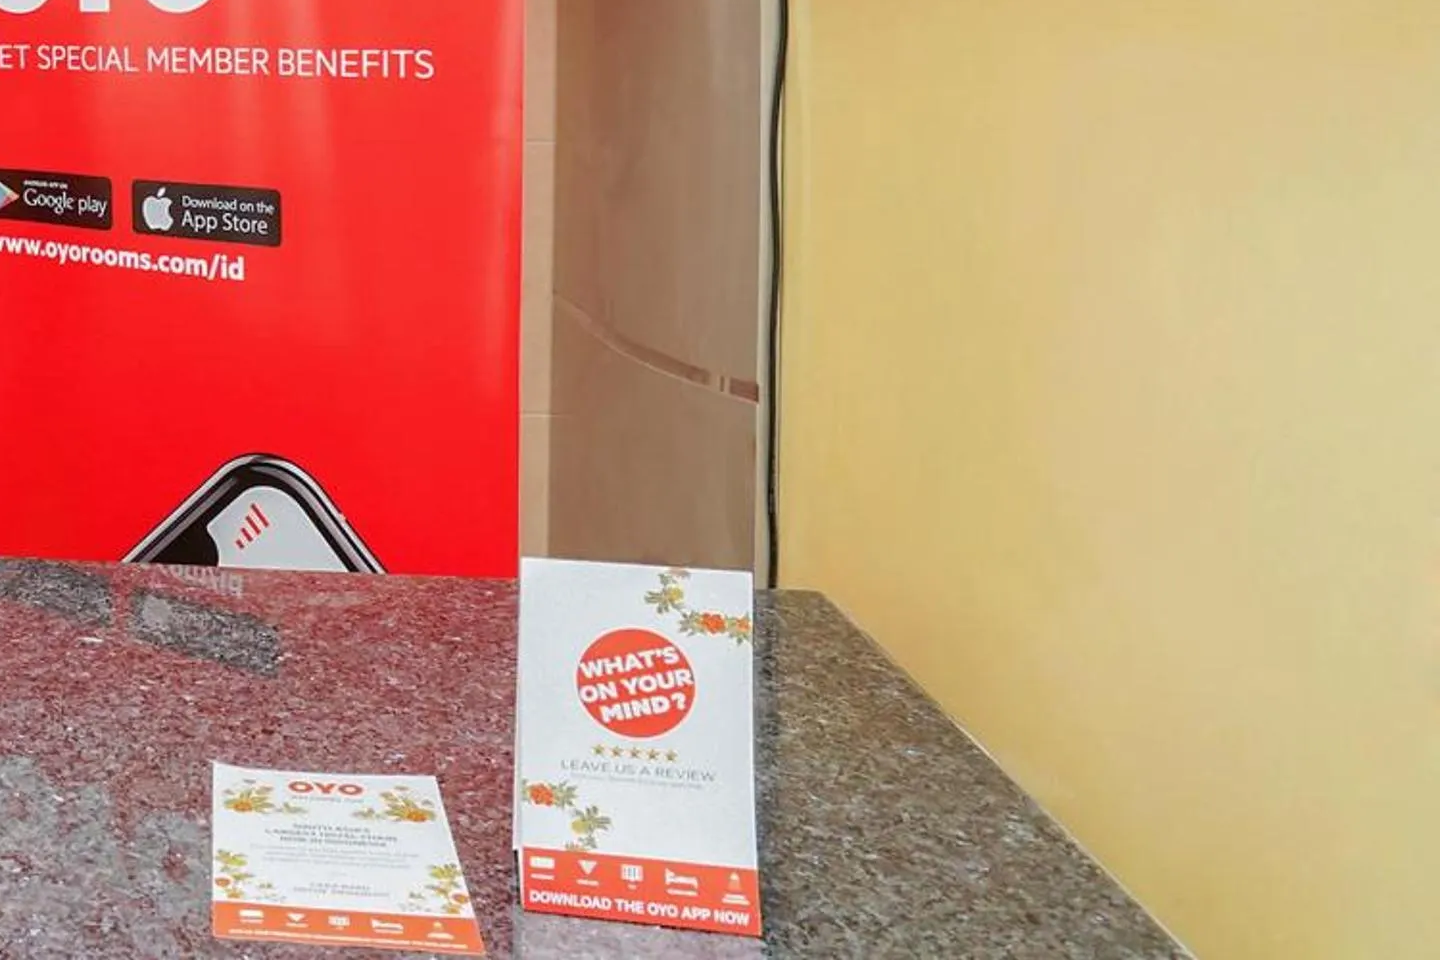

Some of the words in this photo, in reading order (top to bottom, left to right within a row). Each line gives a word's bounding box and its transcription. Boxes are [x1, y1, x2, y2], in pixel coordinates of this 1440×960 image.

[37, 45, 139, 73] SPECIAL
[147, 47, 269, 75] MEMBER
[278, 49, 435, 79] BENEFITS
[23, 188, 74, 215] Google
[78, 194, 108, 218] play
[181, 195, 237, 211] Download
[240, 202, 255, 213] on
[257, 201, 275, 215] the
[181, 210, 218, 233] App
[222, 212, 269, 235] Store
[579, 646, 680, 679] WHAT'S
[580, 683, 618, 704] ON
[621, 668, 694, 696] YOUR
[599, 692, 687, 724] MIND?
[561, 759, 611, 773] LEAVE
[614, 763, 636, 775] US
[639, 765, 651, 776] A
[655, 766, 716, 782] REVIEW
[288, 781, 363, 795] OYO
[528, 889, 612, 911] DOWNLOAD
[614, 898, 645, 915] THE
[647, 901, 678, 918] OYO
[681, 905, 711, 921] APP
[713, 909, 750, 926] NOW
